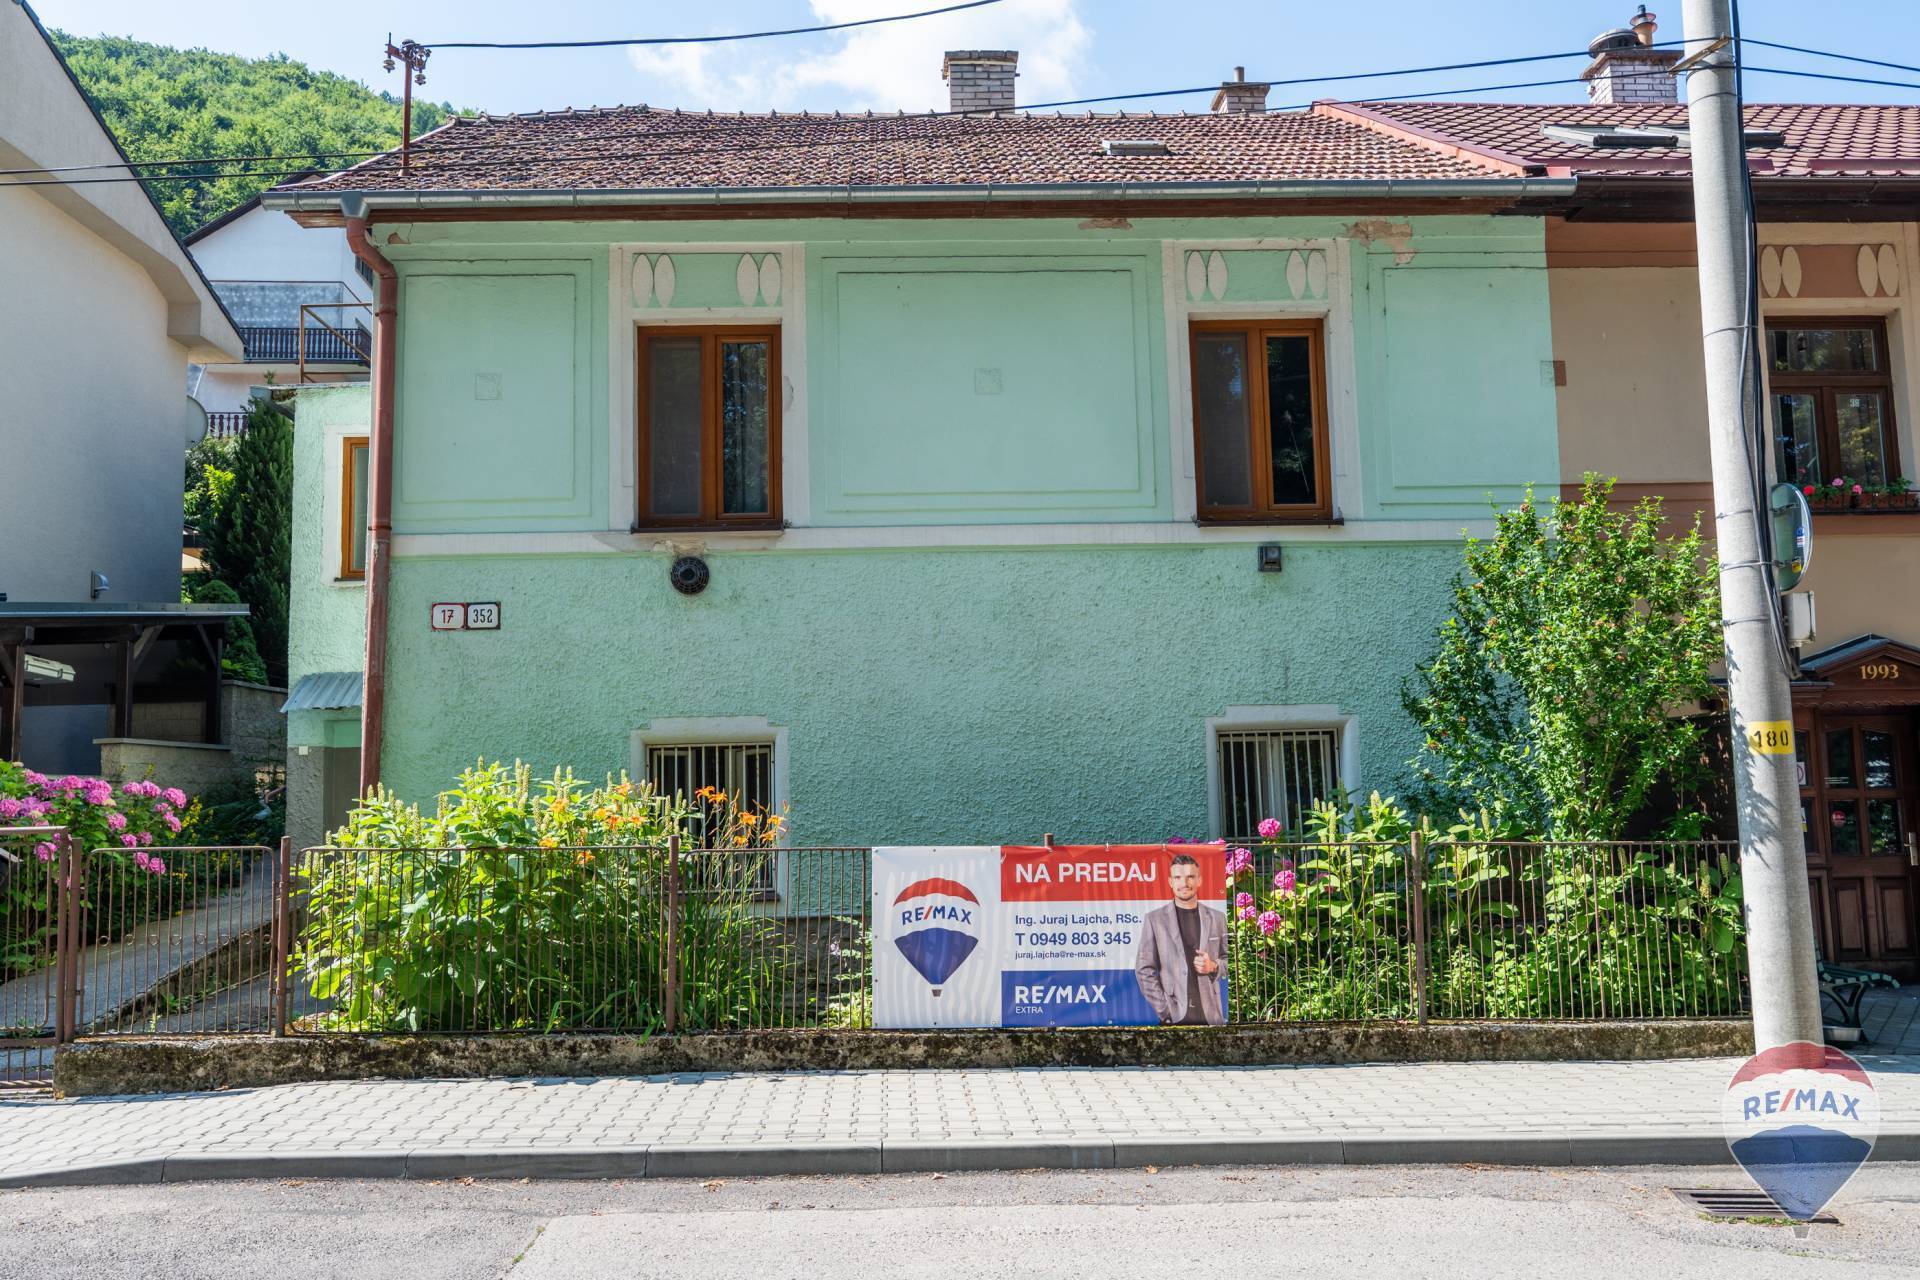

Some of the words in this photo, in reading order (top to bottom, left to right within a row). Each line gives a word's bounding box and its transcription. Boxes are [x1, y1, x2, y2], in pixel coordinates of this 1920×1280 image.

[441, 609, 455, 624] 17
[473, 608, 493, 624] 352
[1859, 664, 1899, 680] 1993
[1753, 730, 1789, 748] 180
[1015, 863, 1051, 883] NA
[1058, 861, 1157, 883] PREDAJ
[901, 904, 973, 926] RE/MAX
[1015, 915, 1037, 927] Ing.
[1039, 914, 1069, 926] Juraj
[1071, 913, 1113, 925] Lajcha,
[1115, 913, 1142, 925] RSc.
[1015, 933, 1026, 946] T
[1029, 932, 1067, 946] 0949
[1071, 932, 1100, 945] 803
[1103, 931, 1132, 945] 345
[1015, 950, 1107, 960] juraj.lajcha@re-max.sk
[1015, 985, 1107, 1004] RE/MAX
[1015, 1006, 1044, 1014] EXTRA
